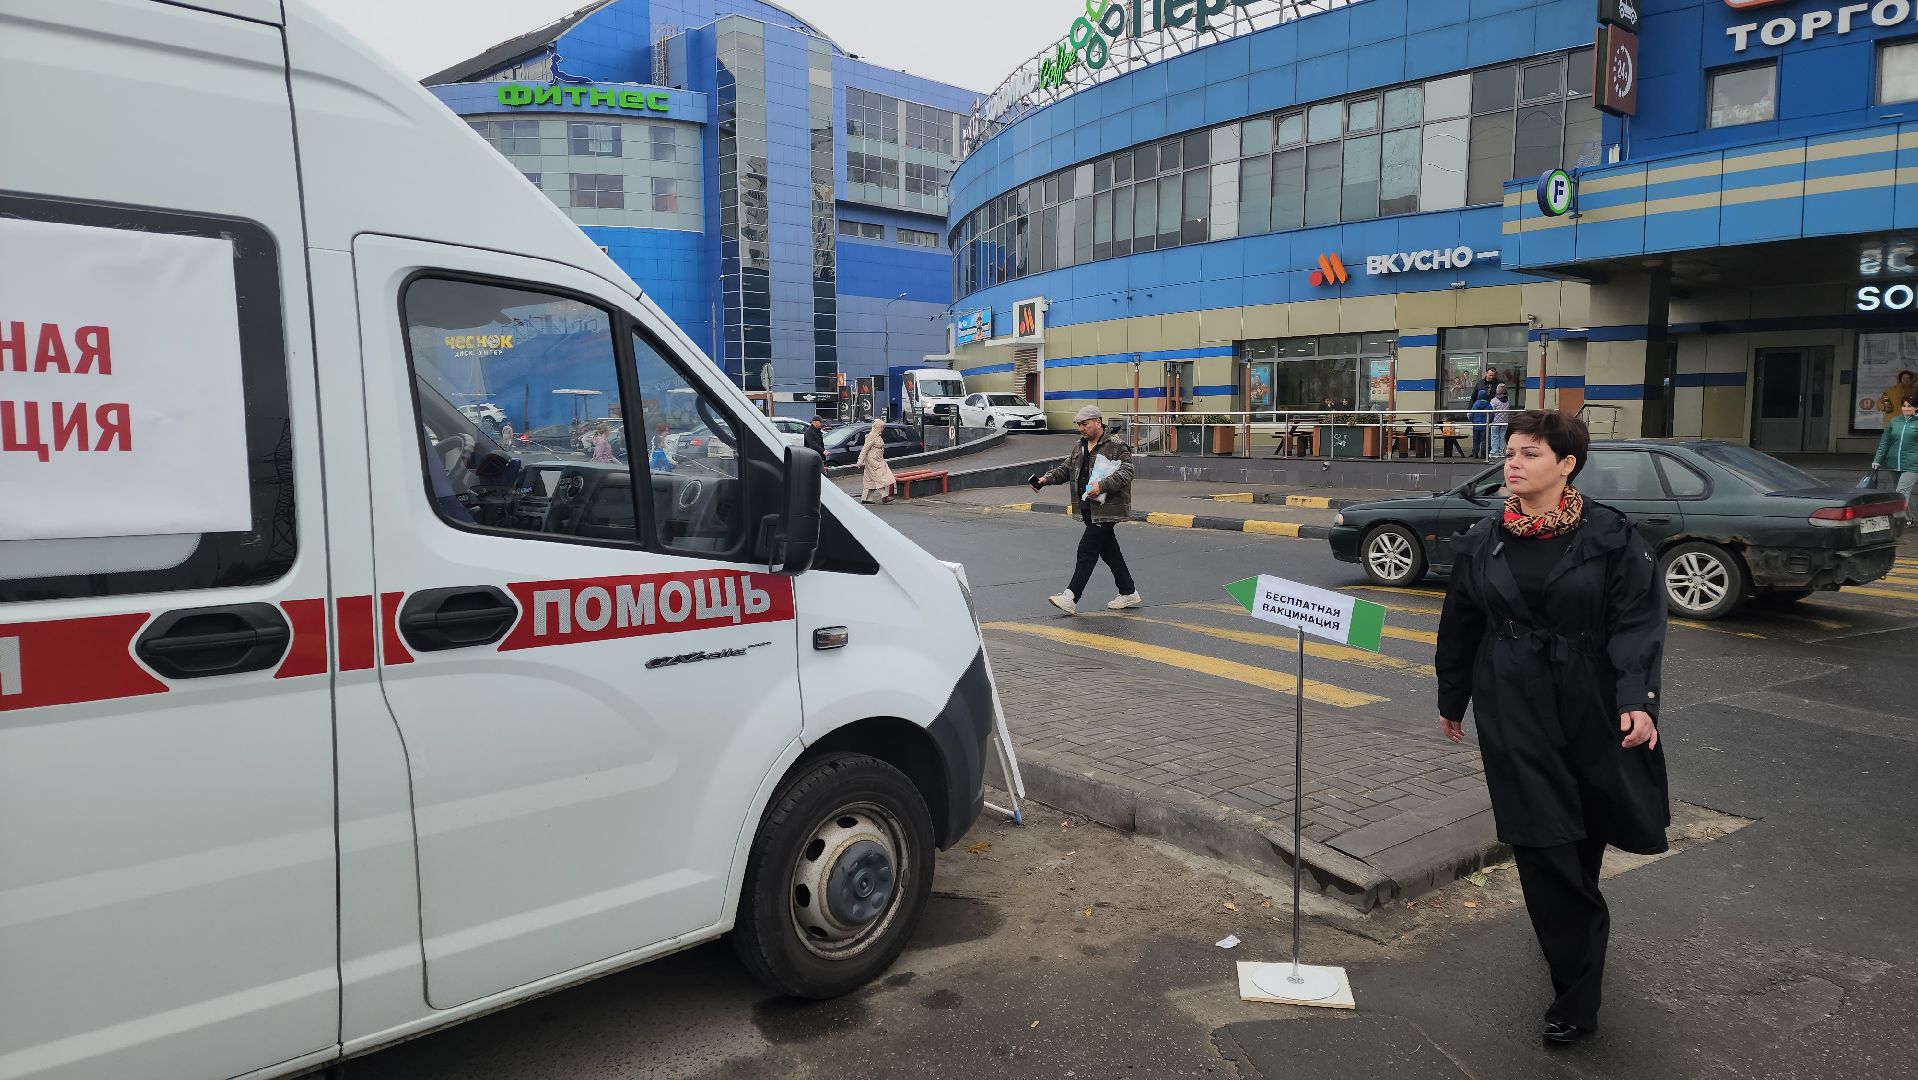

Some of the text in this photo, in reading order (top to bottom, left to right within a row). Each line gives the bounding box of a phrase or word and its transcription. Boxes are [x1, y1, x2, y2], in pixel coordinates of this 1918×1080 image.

[1726, 0, 1918, 51] ТОРГО
[1366, 245, 1473, 275] ВКУСНО
[1856, 284, 1918, 311] SO
[0, 400, 132, 462] ЦИЯ
[533, 575, 771, 636] ПОМОЩЬ
[1262, 603, 1340, 630] ВАКЦИНАЦИЯ
[1265, 591, 1341, 618] БЕСПЛАТНАЯ
